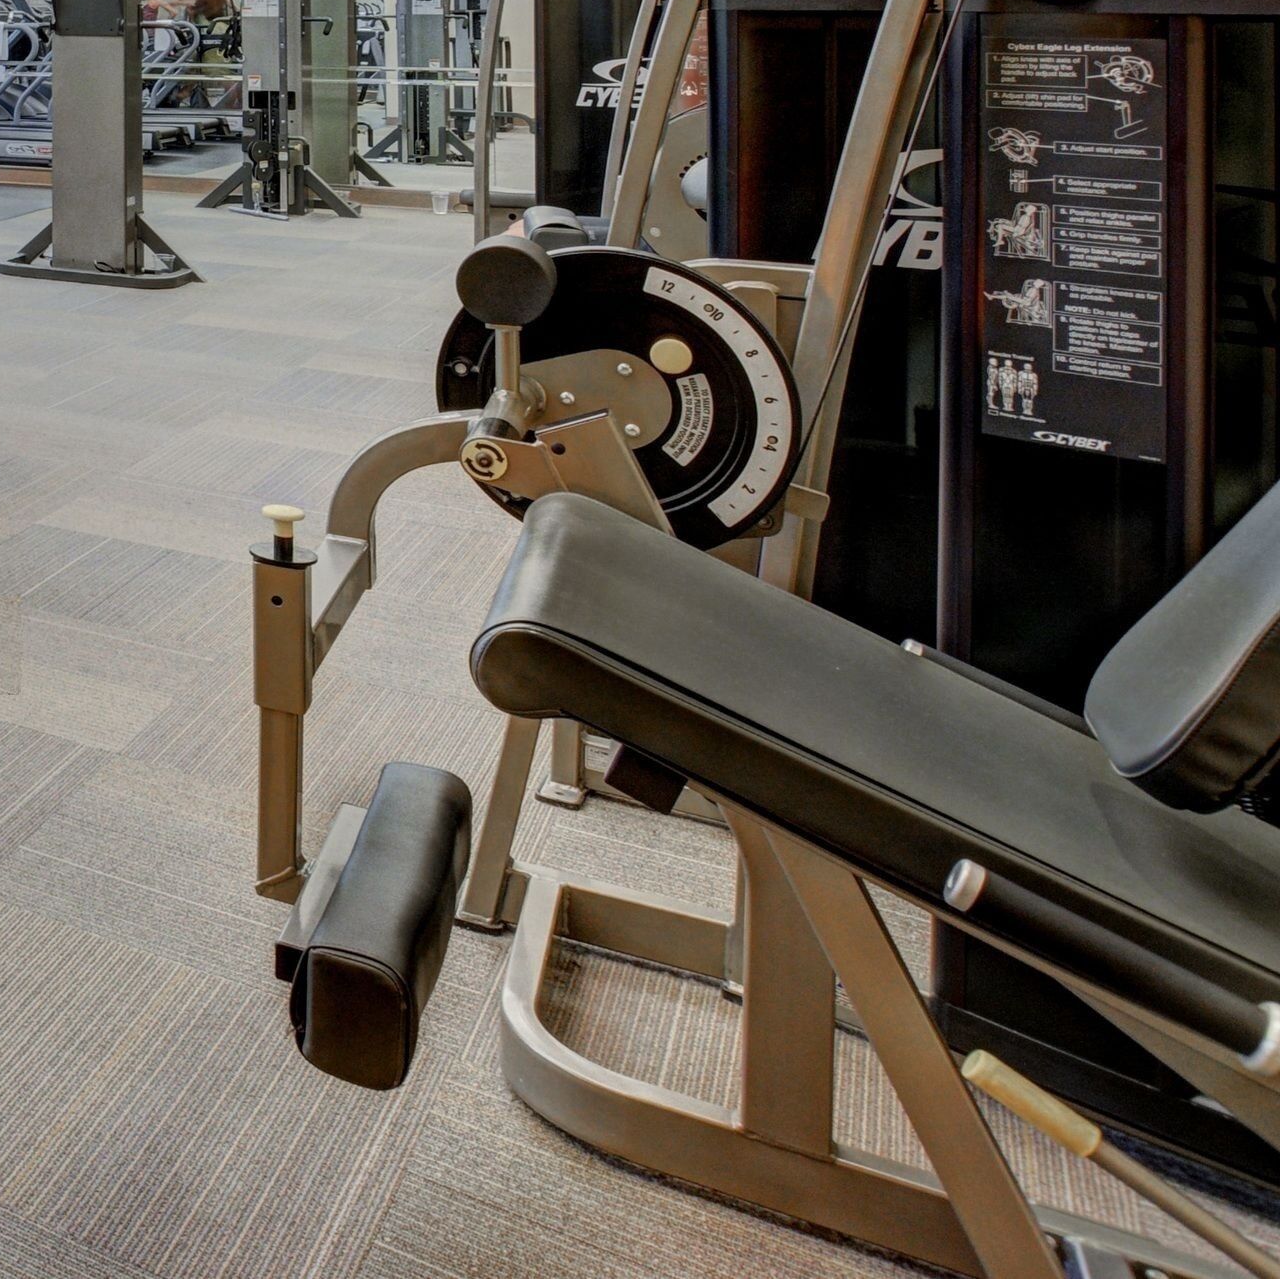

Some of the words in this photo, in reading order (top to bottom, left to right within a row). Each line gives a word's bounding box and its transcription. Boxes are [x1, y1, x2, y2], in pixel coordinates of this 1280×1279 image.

[1007, 43, 1035, 52] Cybex
[1037, 43, 1063, 52] Eagle
[1064, 44, 1082, 52] Leg
[1084, 44, 1132, 53] Extension
[1029, 63, 1038, 71] by
[1039, 63, 1059, 71] lifting
[1035, 70, 1058, 78] adjust
[1002, 92, 1024, 100] Adjust
[1057, 94, 1072, 102] pad
[1044, 101, 1085, 110] positioning.
[1070, 145, 1094, 153] Adjust
[1114, 148, 1147, 156] position.
[1092, 181, 1137, 190] appropriate
[1069, 209, 1100, 217] Position
[1100, 210, 1125, 220] thighs
[1125, 214, 1156, 222] parallel
[1106, 219, 1134, 228] ankles.
[1069, 231, 1086, 239] Grip
[1087, 232, 1118, 241] handles
[1119, 235, 1143, 244] firmly.
[1069, 245, 1090, 254] Keep
[1091, 247, 1110, 255] back
[1110, 249, 1140, 259] against
[1069, 260, 1100, 268] posture.
[1085, 255, 1119, 263] maintain
[1119, 258, 1146, 266] proper
[661, 279, 676, 294] 12
[1069, 284, 1109, 295] Straighten
[1109, 289, 1134, 298] knees
[1080, 293, 1115, 302] possible.
[711, 308, 725, 322] 10
[1064, 304, 1092, 314] NOTE:
[1093, 308, 1105, 316] Do
[1120, 311, 1138, 320] kick.
[1069, 316, 1095, 326] Rotate
[1095, 319, 1120, 329] thighs
[1069, 325, 1099, 334] position
[1099, 328, 1120, 336] knee
[1120, 331, 1140, 339] caps
[1069, 331, 1097, 341] directly
[1109, 336, 1148, 347] top/center
[745, 350, 759, 358] 8
[1069, 346, 1100, 355] position.
[1056, 355, 1068, 363] 10.
[1069, 357, 1097, 366] Control
[1098, 362, 1122, 370] return
[1069, 365, 1098, 375] starting
[1098, 369, 1131, 379] position.
[681, 384, 691, 397] ARM
[688, 377, 700, 397] RELEASE
[701, 388, 709, 396] TO
[702, 397, 711, 415] SELECT
[683, 405, 693, 427] DESIRED
[701, 415, 710, 431] START
[685, 431, 696, 446] MOVE
[688, 431, 706, 455] POSITION
[1055, 434, 1111, 452] CYBEX
[672, 445, 687, 459] INPUT
[763, 444, 777, 453] 4
[741, 484, 756, 495] 2
